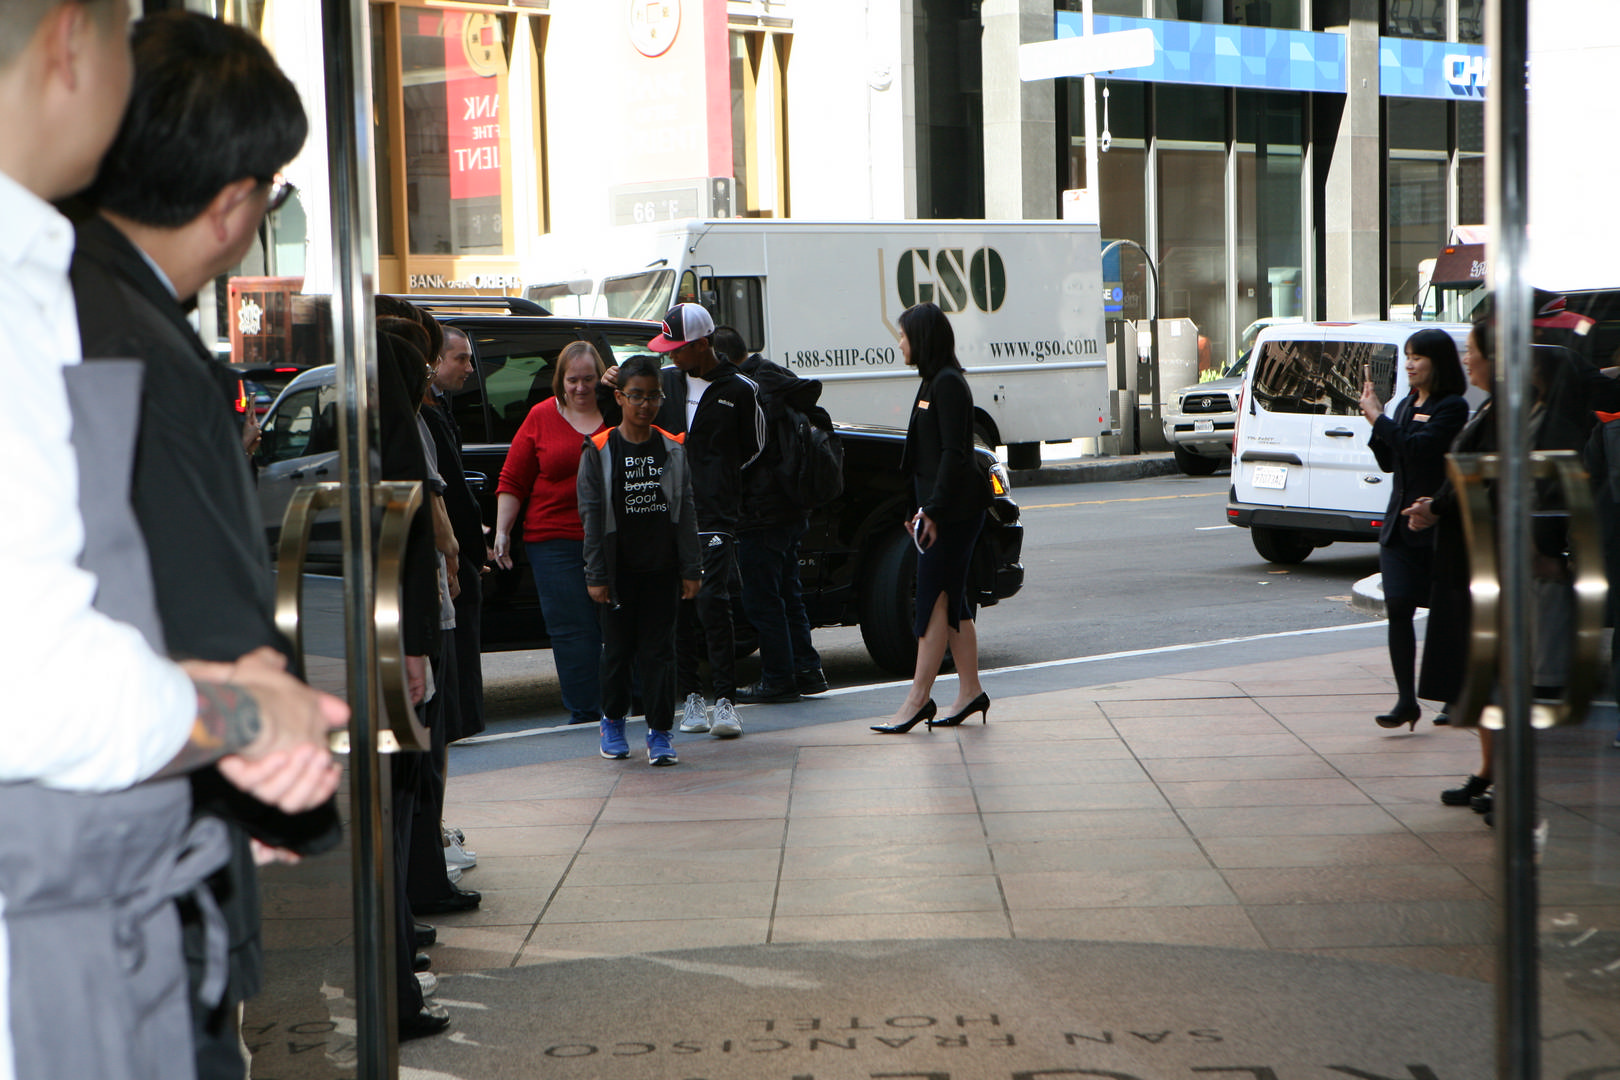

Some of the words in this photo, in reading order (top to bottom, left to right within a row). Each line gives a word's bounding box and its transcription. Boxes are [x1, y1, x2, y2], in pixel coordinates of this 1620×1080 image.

[410, 274, 445, 288] BANK
[896, 246, 1007, 315] GSO
[784, 347, 895, 369] 1-888-SHIP-GSO
[990, 337, 1098, 363] www.gso.com
[625, 456, 655, 468] Boys
[625, 466, 645, 479] will
[648, 465, 664, 476] be
[625, 491, 657, 506] Good
[747, 1013, 1001, 1032] HOTEL
[544, 1031, 1017, 1058] FRANCISCO
[1063, 1028, 1224, 1046] SAN
